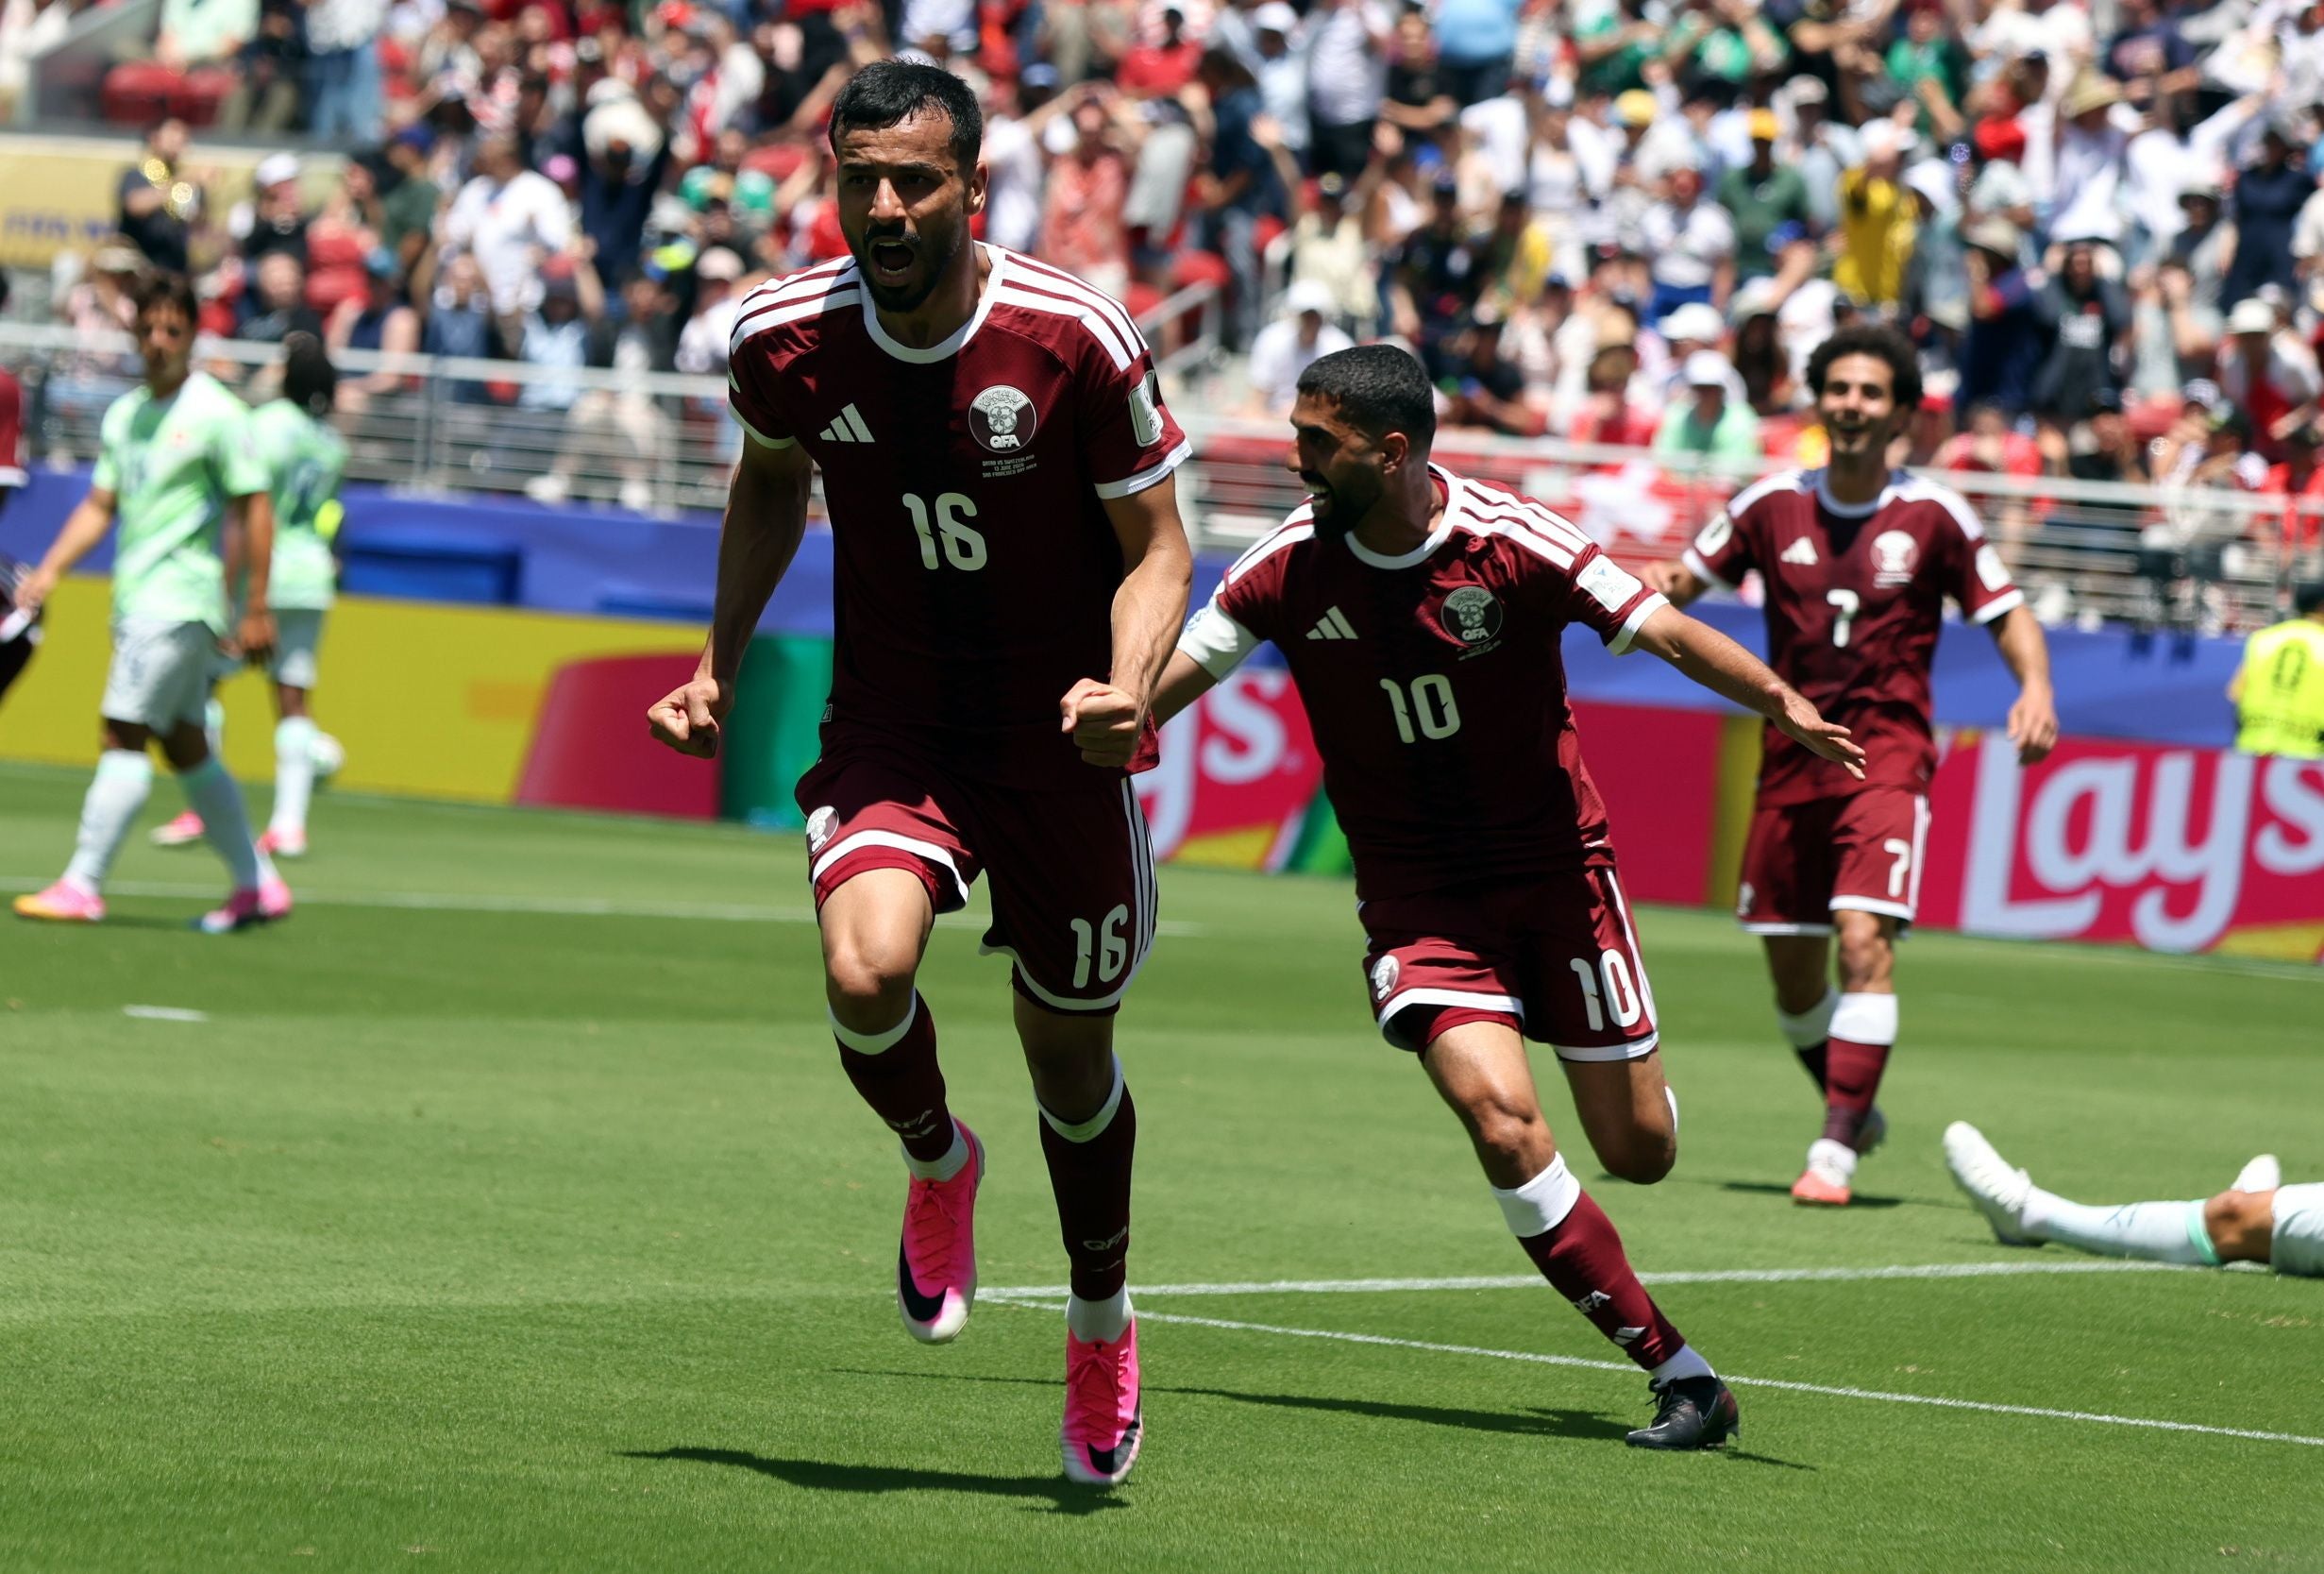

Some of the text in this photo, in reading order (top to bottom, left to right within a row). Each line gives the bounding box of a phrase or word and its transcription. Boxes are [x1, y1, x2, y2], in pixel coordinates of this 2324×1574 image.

[989, 434, 1020, 449] QFA
[902, 492, 987, 571] 16
[1461, 627, 1490, 641] QFA
[1827, 588, 1860, 648] 7
[1379, 673, 1461, 744] 10
[1883, 838, 1911, 898] 7
[1069, 903, 1129, 990] 16
[1569, 948, 1642, 1032] 10
